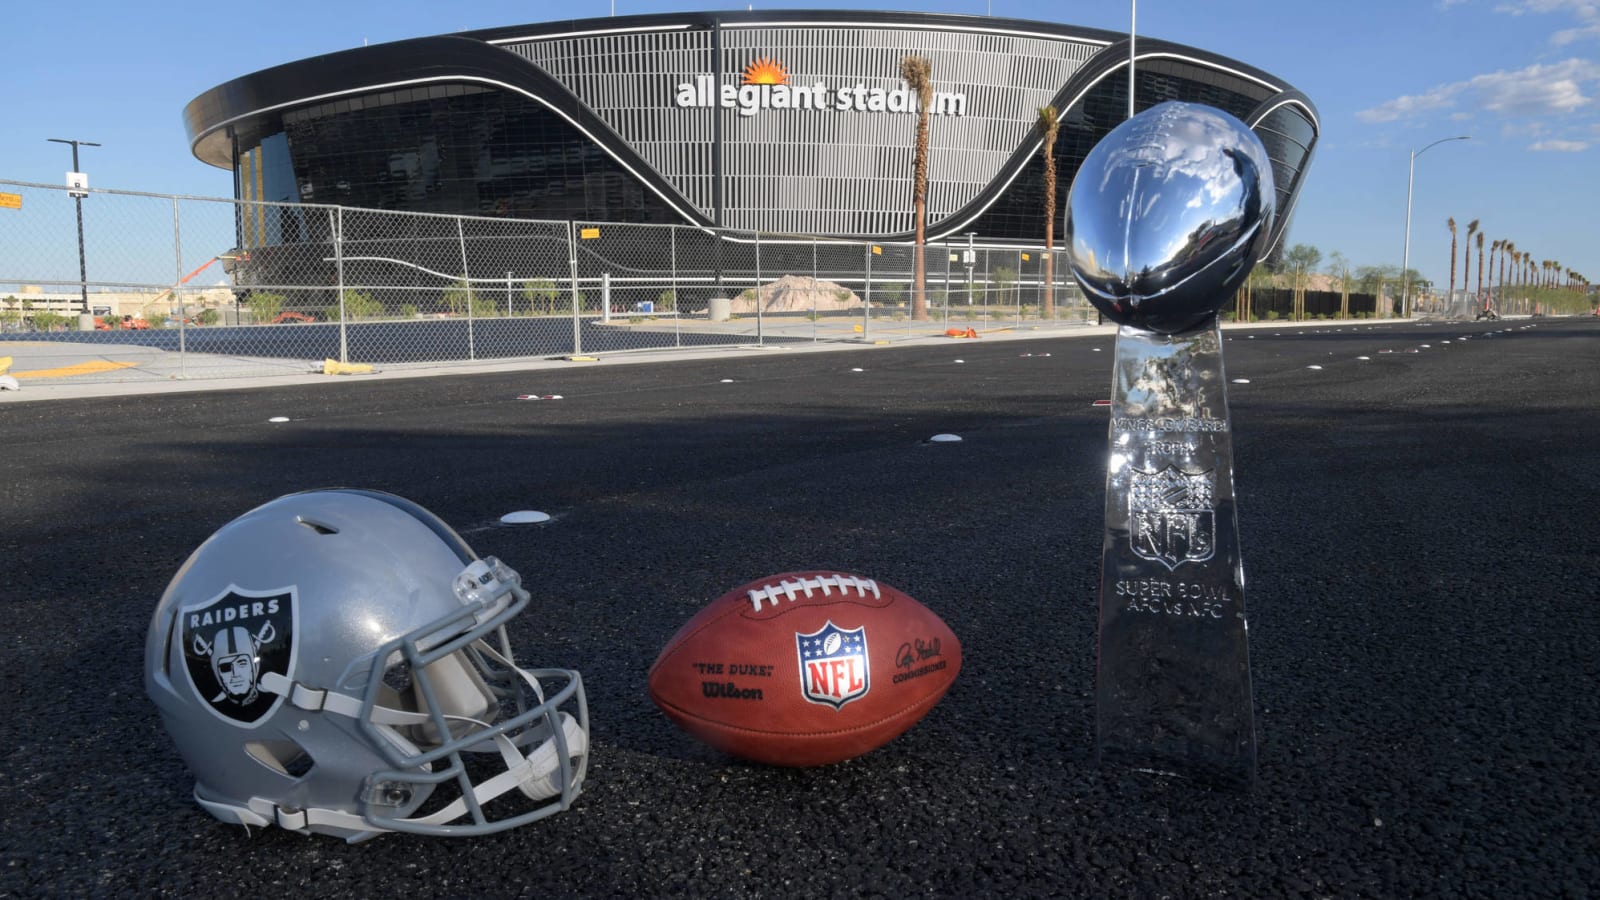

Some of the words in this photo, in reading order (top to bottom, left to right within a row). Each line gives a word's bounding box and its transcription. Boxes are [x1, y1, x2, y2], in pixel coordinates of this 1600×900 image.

[676, 75, 827, 116] allegiant
[1115, 578, 1172, 598] SUPER
[1178, 582, 1231, 601] BOWL
[190, 599, 280, 629] RAIDERS
[702, 681, 763, 700] Wilson
[808, 659, 863, 698] NFL
